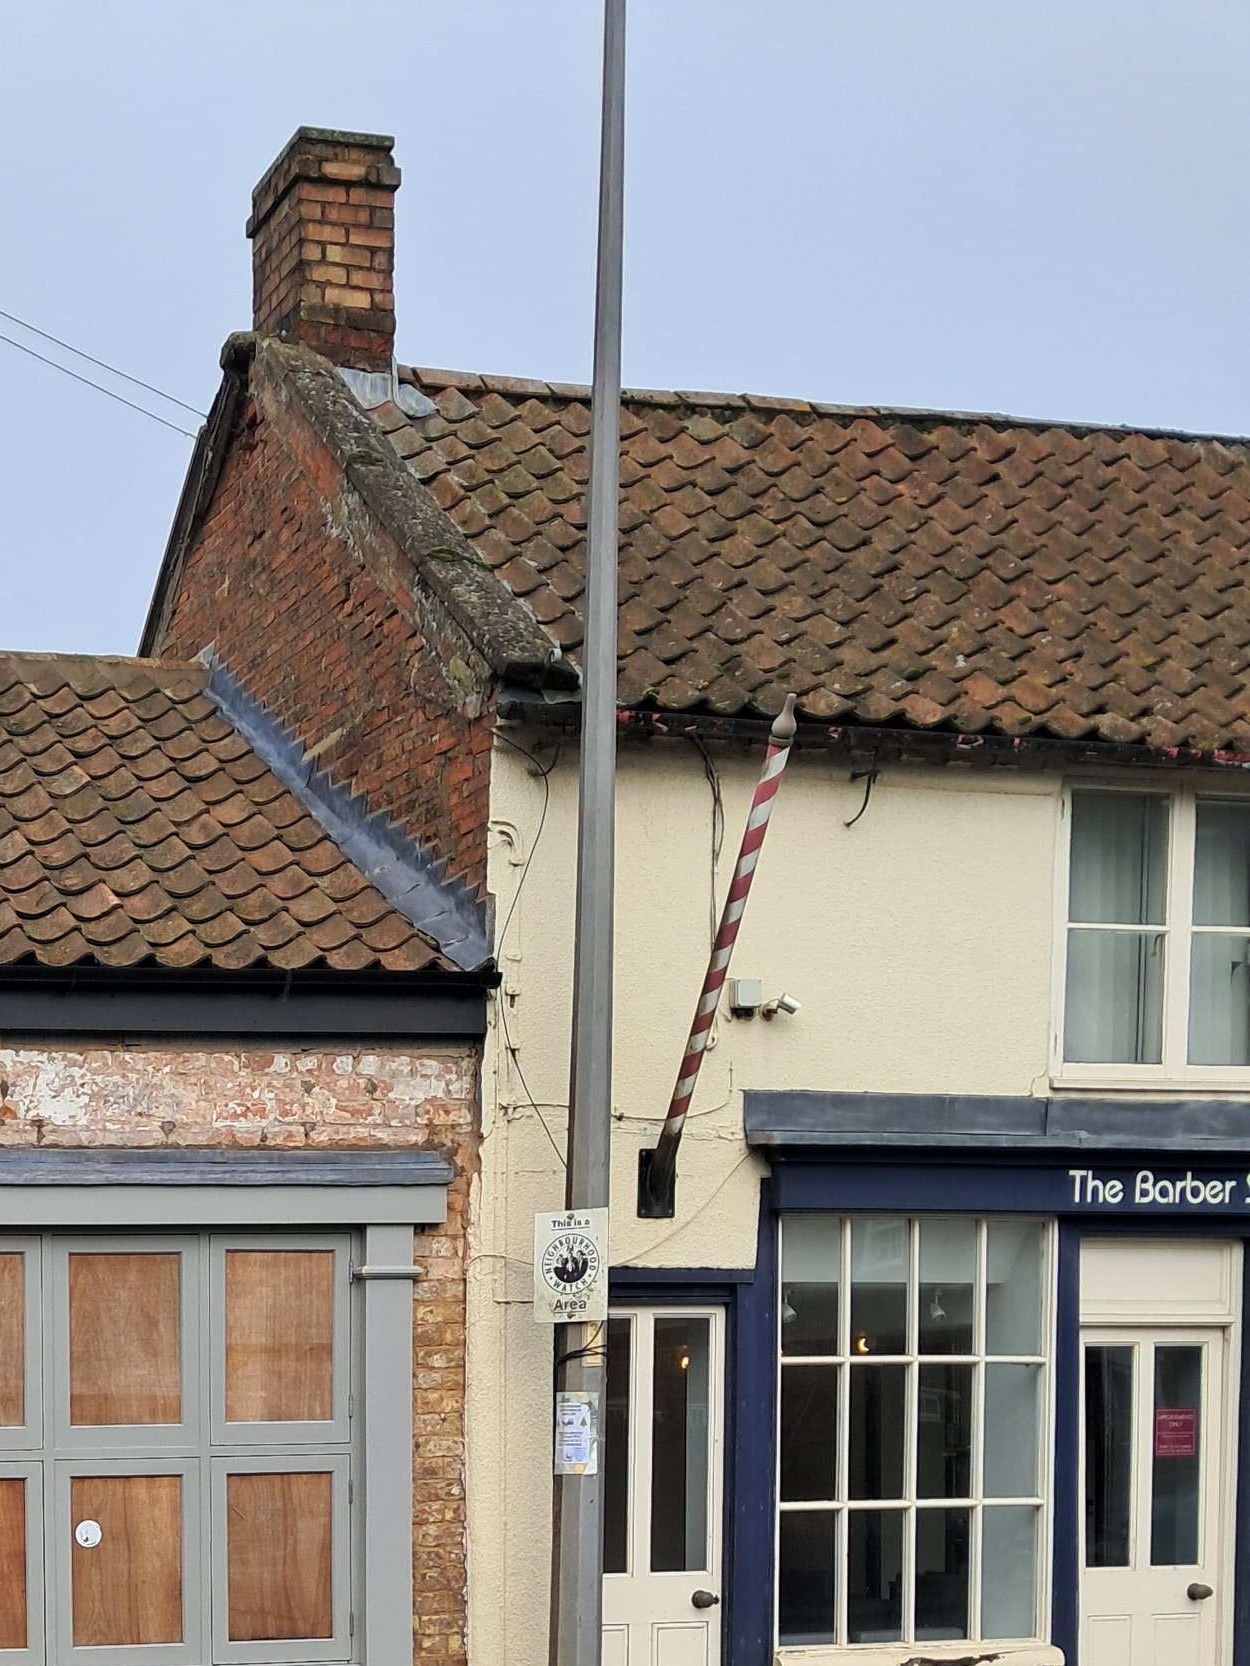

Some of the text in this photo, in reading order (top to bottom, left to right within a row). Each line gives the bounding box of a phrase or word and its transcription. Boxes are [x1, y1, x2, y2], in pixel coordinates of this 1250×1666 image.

[1069, 1170, 1123, 1203] The
[1135, 1170, 1237, 1203] Barber
[552, 1220, 571, 1228] This
[574, 1218, 581, 1226] is
[544, 1236, 597, 1275] NEIGHBOURHOOD
[553, 1278, 588, 1292] WATCH
[553, 1299, 587, 1311] Area
